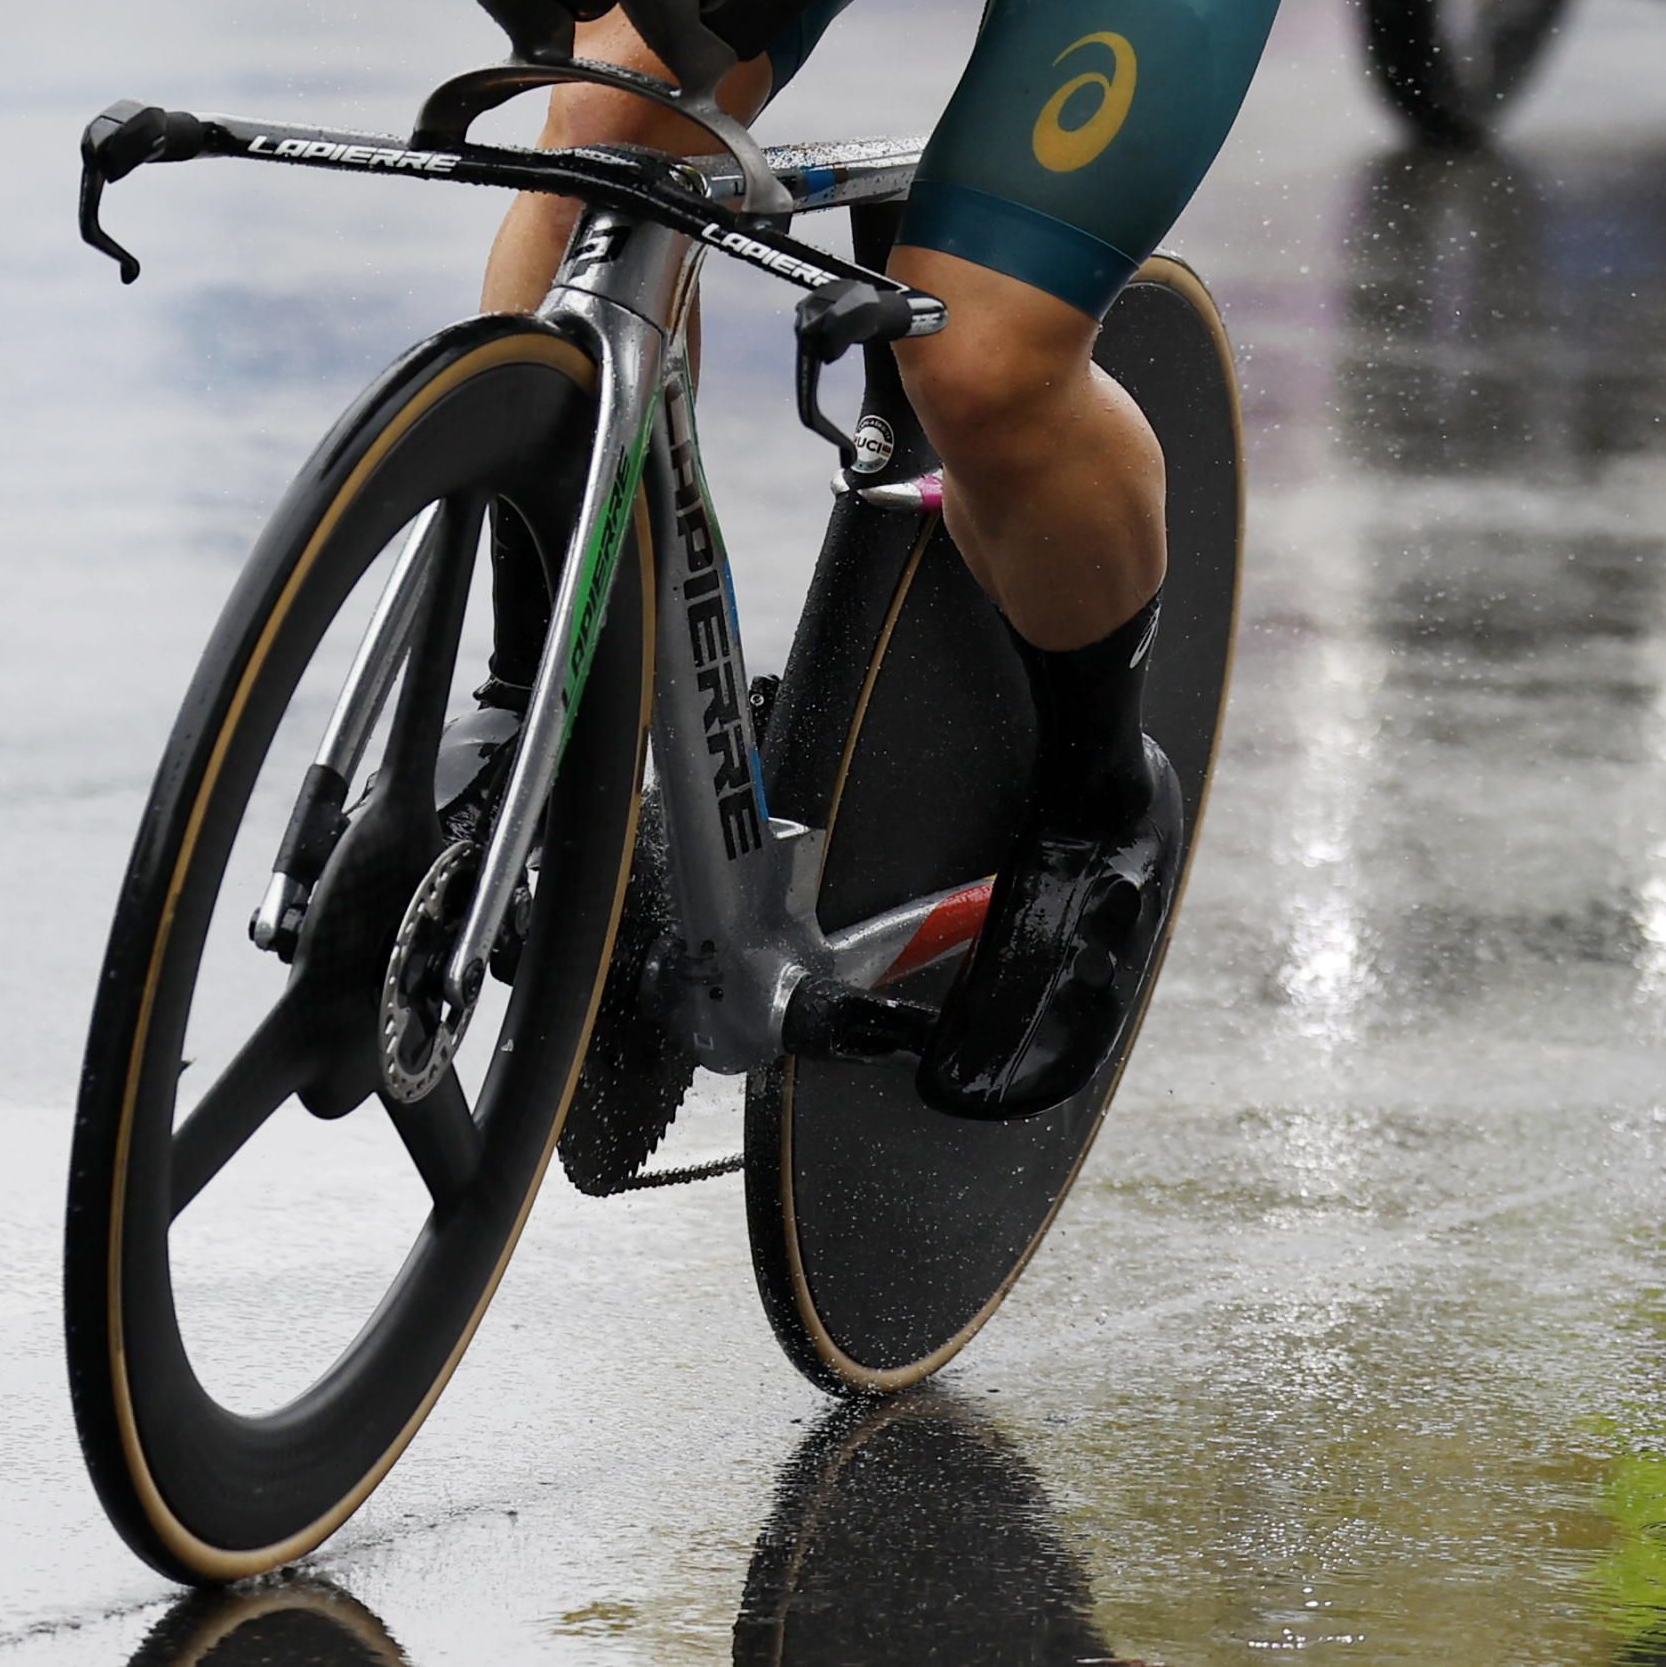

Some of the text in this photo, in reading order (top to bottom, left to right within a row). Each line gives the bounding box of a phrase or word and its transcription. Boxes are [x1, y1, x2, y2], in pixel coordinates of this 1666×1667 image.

[247, 135, 462, 172] LAPIERRE
[856, 437, 882, 454] UCI
[665, 380, 765, 862] LAPIERRE
